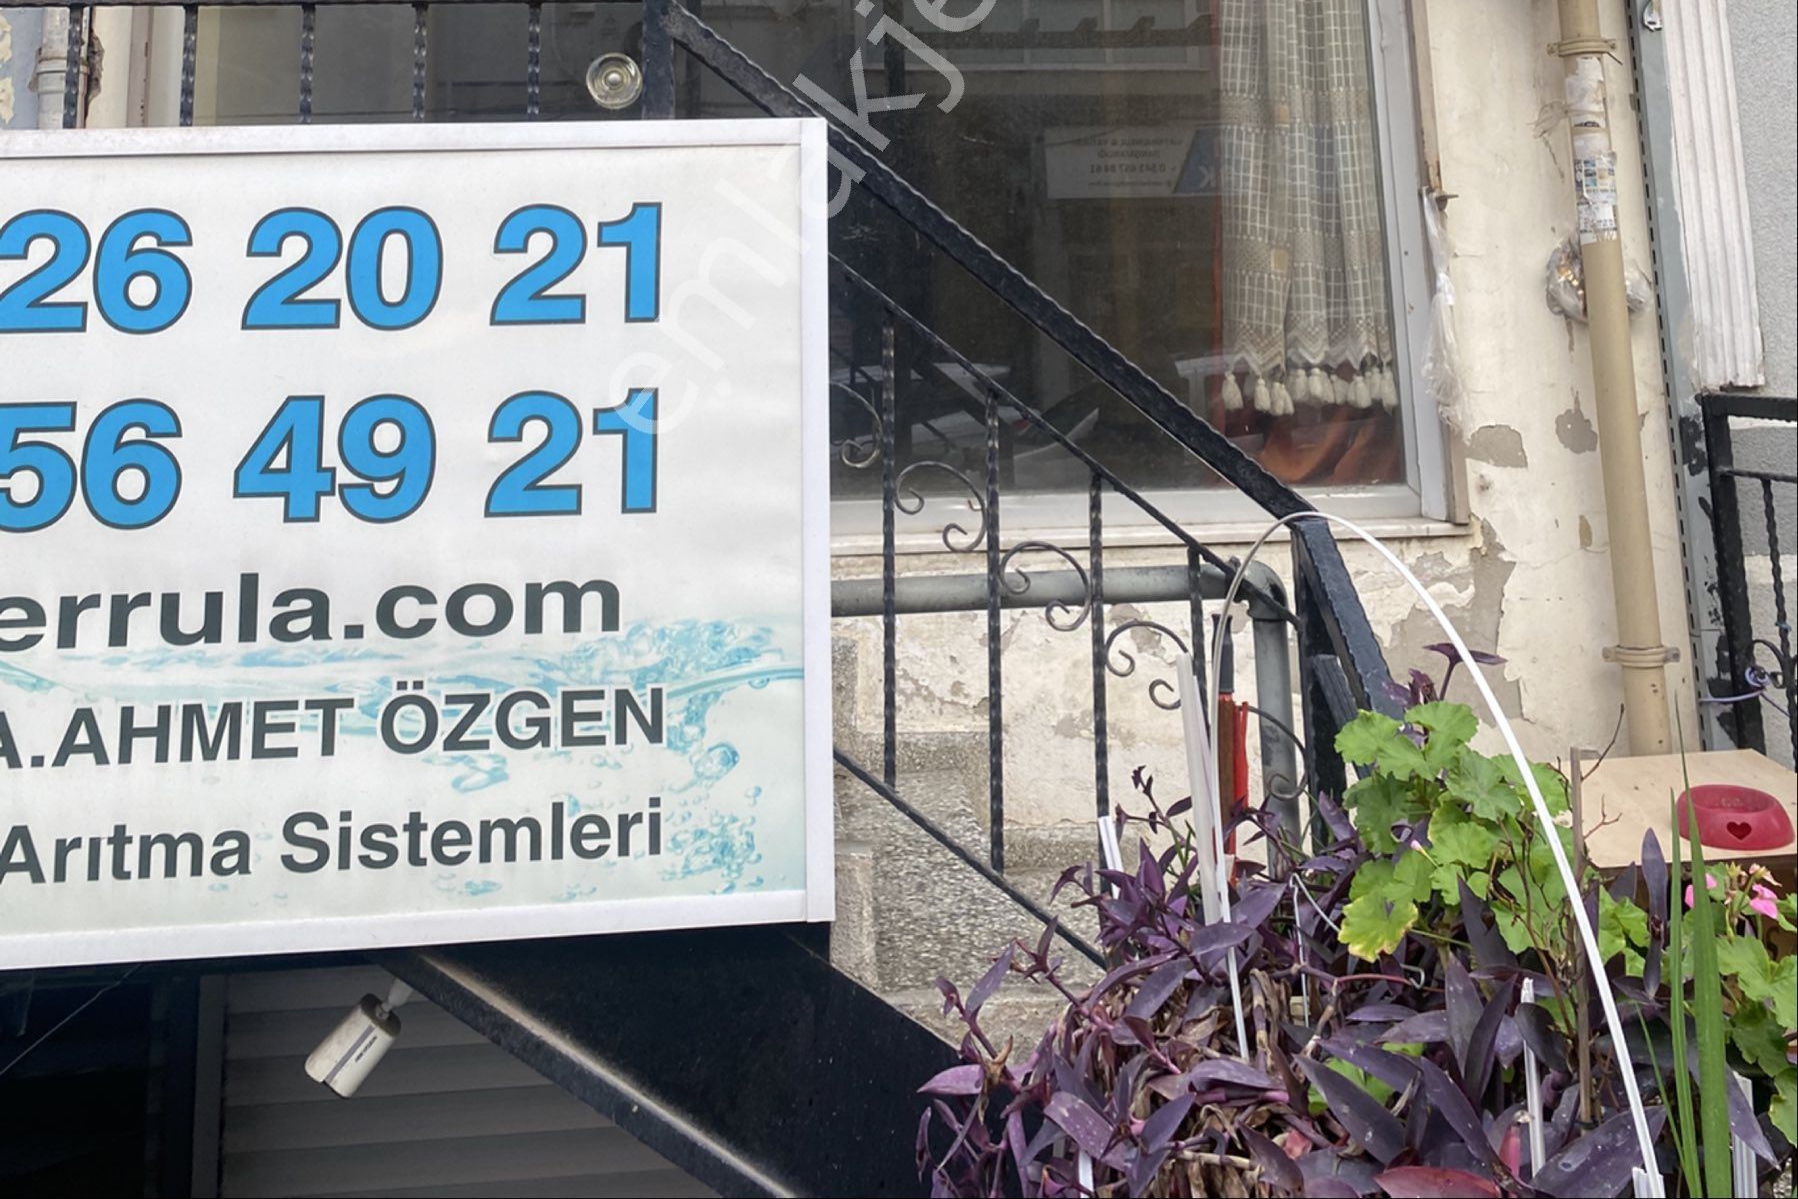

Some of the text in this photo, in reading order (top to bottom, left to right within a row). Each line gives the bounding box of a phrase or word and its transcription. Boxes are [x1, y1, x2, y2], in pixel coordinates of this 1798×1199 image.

[0, 202, 662, 335] 26 20 21
[0, 388, 658, 533] 56 49 21
[0, 573, 621, 652] errula.com
[381, 680, 664, 755] ÖZGEN
[0, 797, 661, 884] Arıtma Sistemleri
